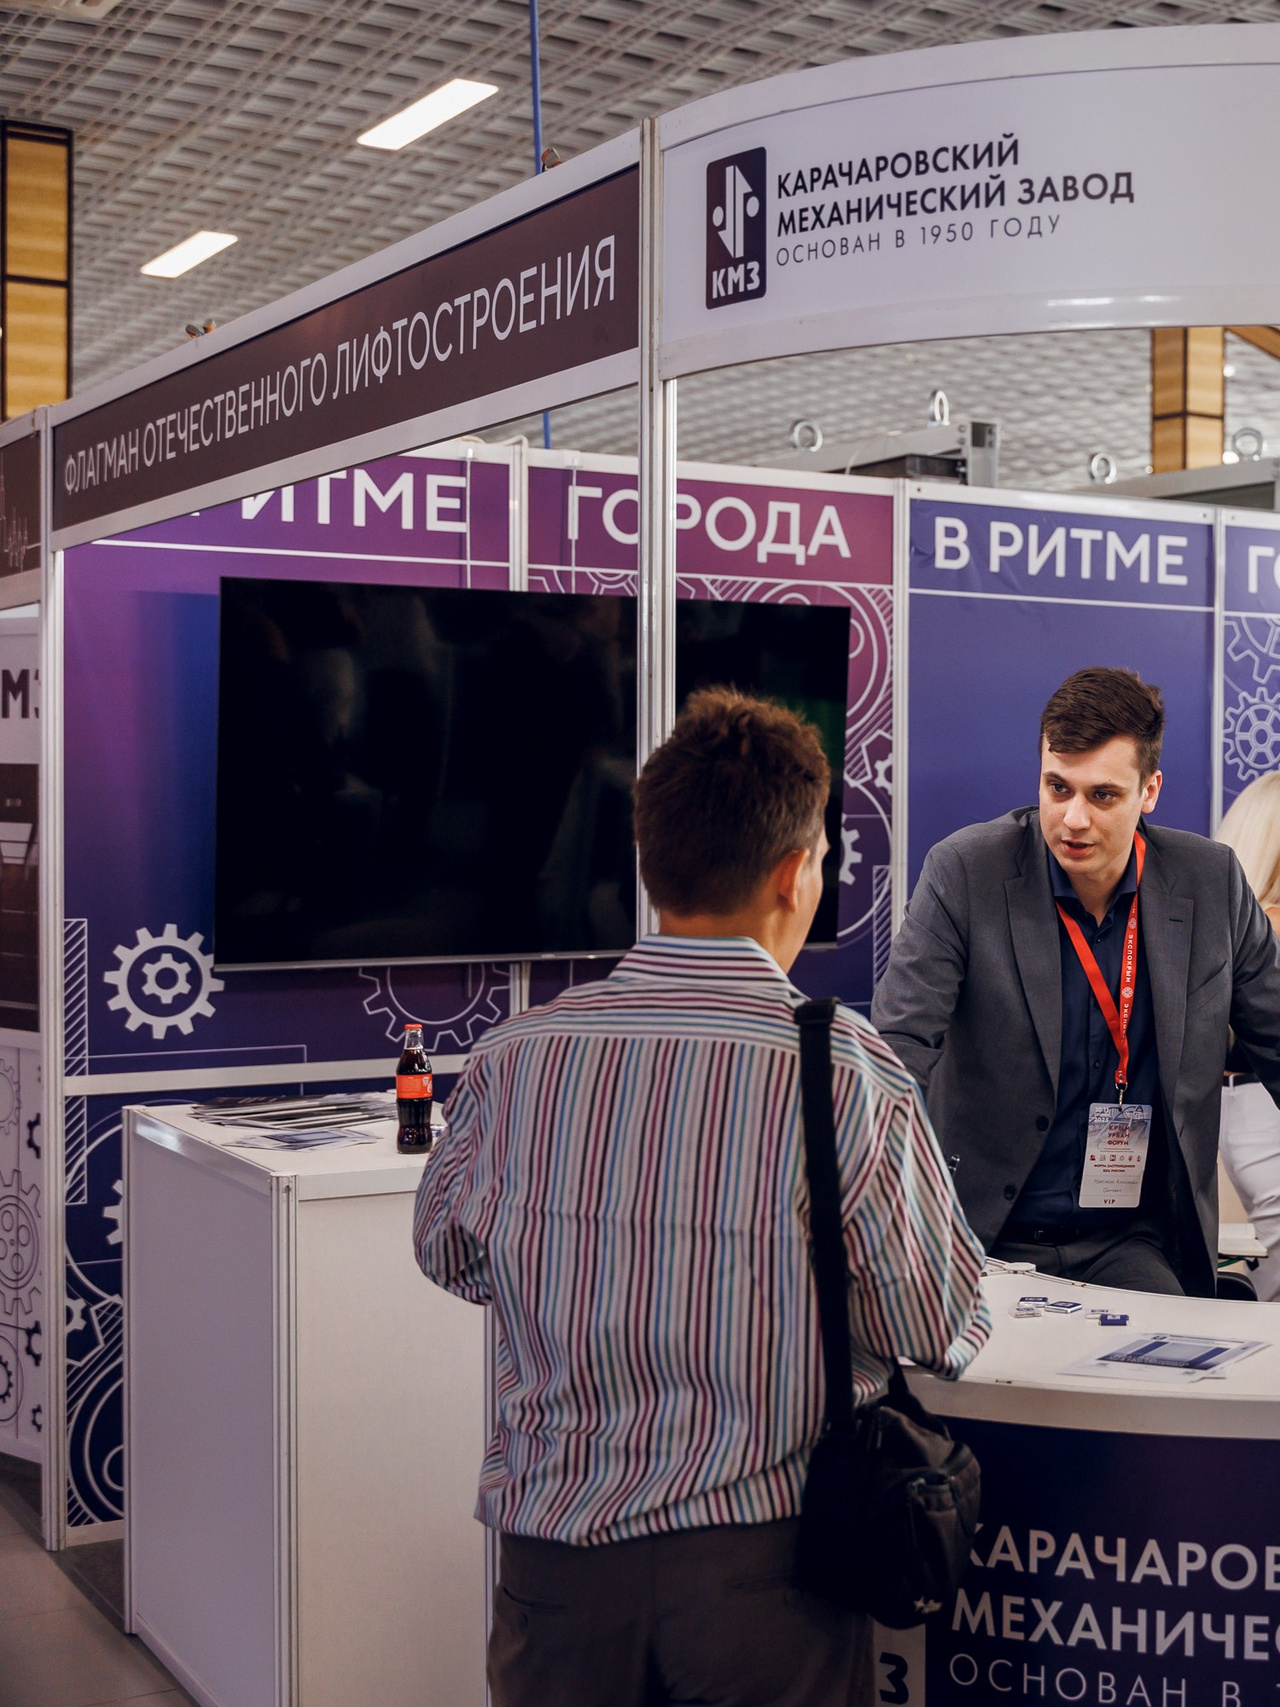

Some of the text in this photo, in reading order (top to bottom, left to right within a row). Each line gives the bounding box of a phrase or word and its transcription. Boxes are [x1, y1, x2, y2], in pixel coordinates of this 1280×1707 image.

[777, 132, 1019, 199] КАРАЧАРОВСКИЙ
[776, 171, 1135, 237] МЕХАНИЧЕСКИЙ ЗАВОД
[776, 214, 1061, 266] ОСНОВАН В 1950 ГОДУ
[711, 260, 762, 299] КМЗ
[64, 234, 617, 495] ФЛАГМАН ОТЕЧЕСТВЕННОГО ЛИФТОСТРОЕНИЯ
[190, 468, 468, 534] ИТМЕ
[934, 516, 1189, 585] В РИТМЕ
[949, 1653, 1187, 1707] ОСНОВАН
[1221, 1680, 1241, 1707] В
